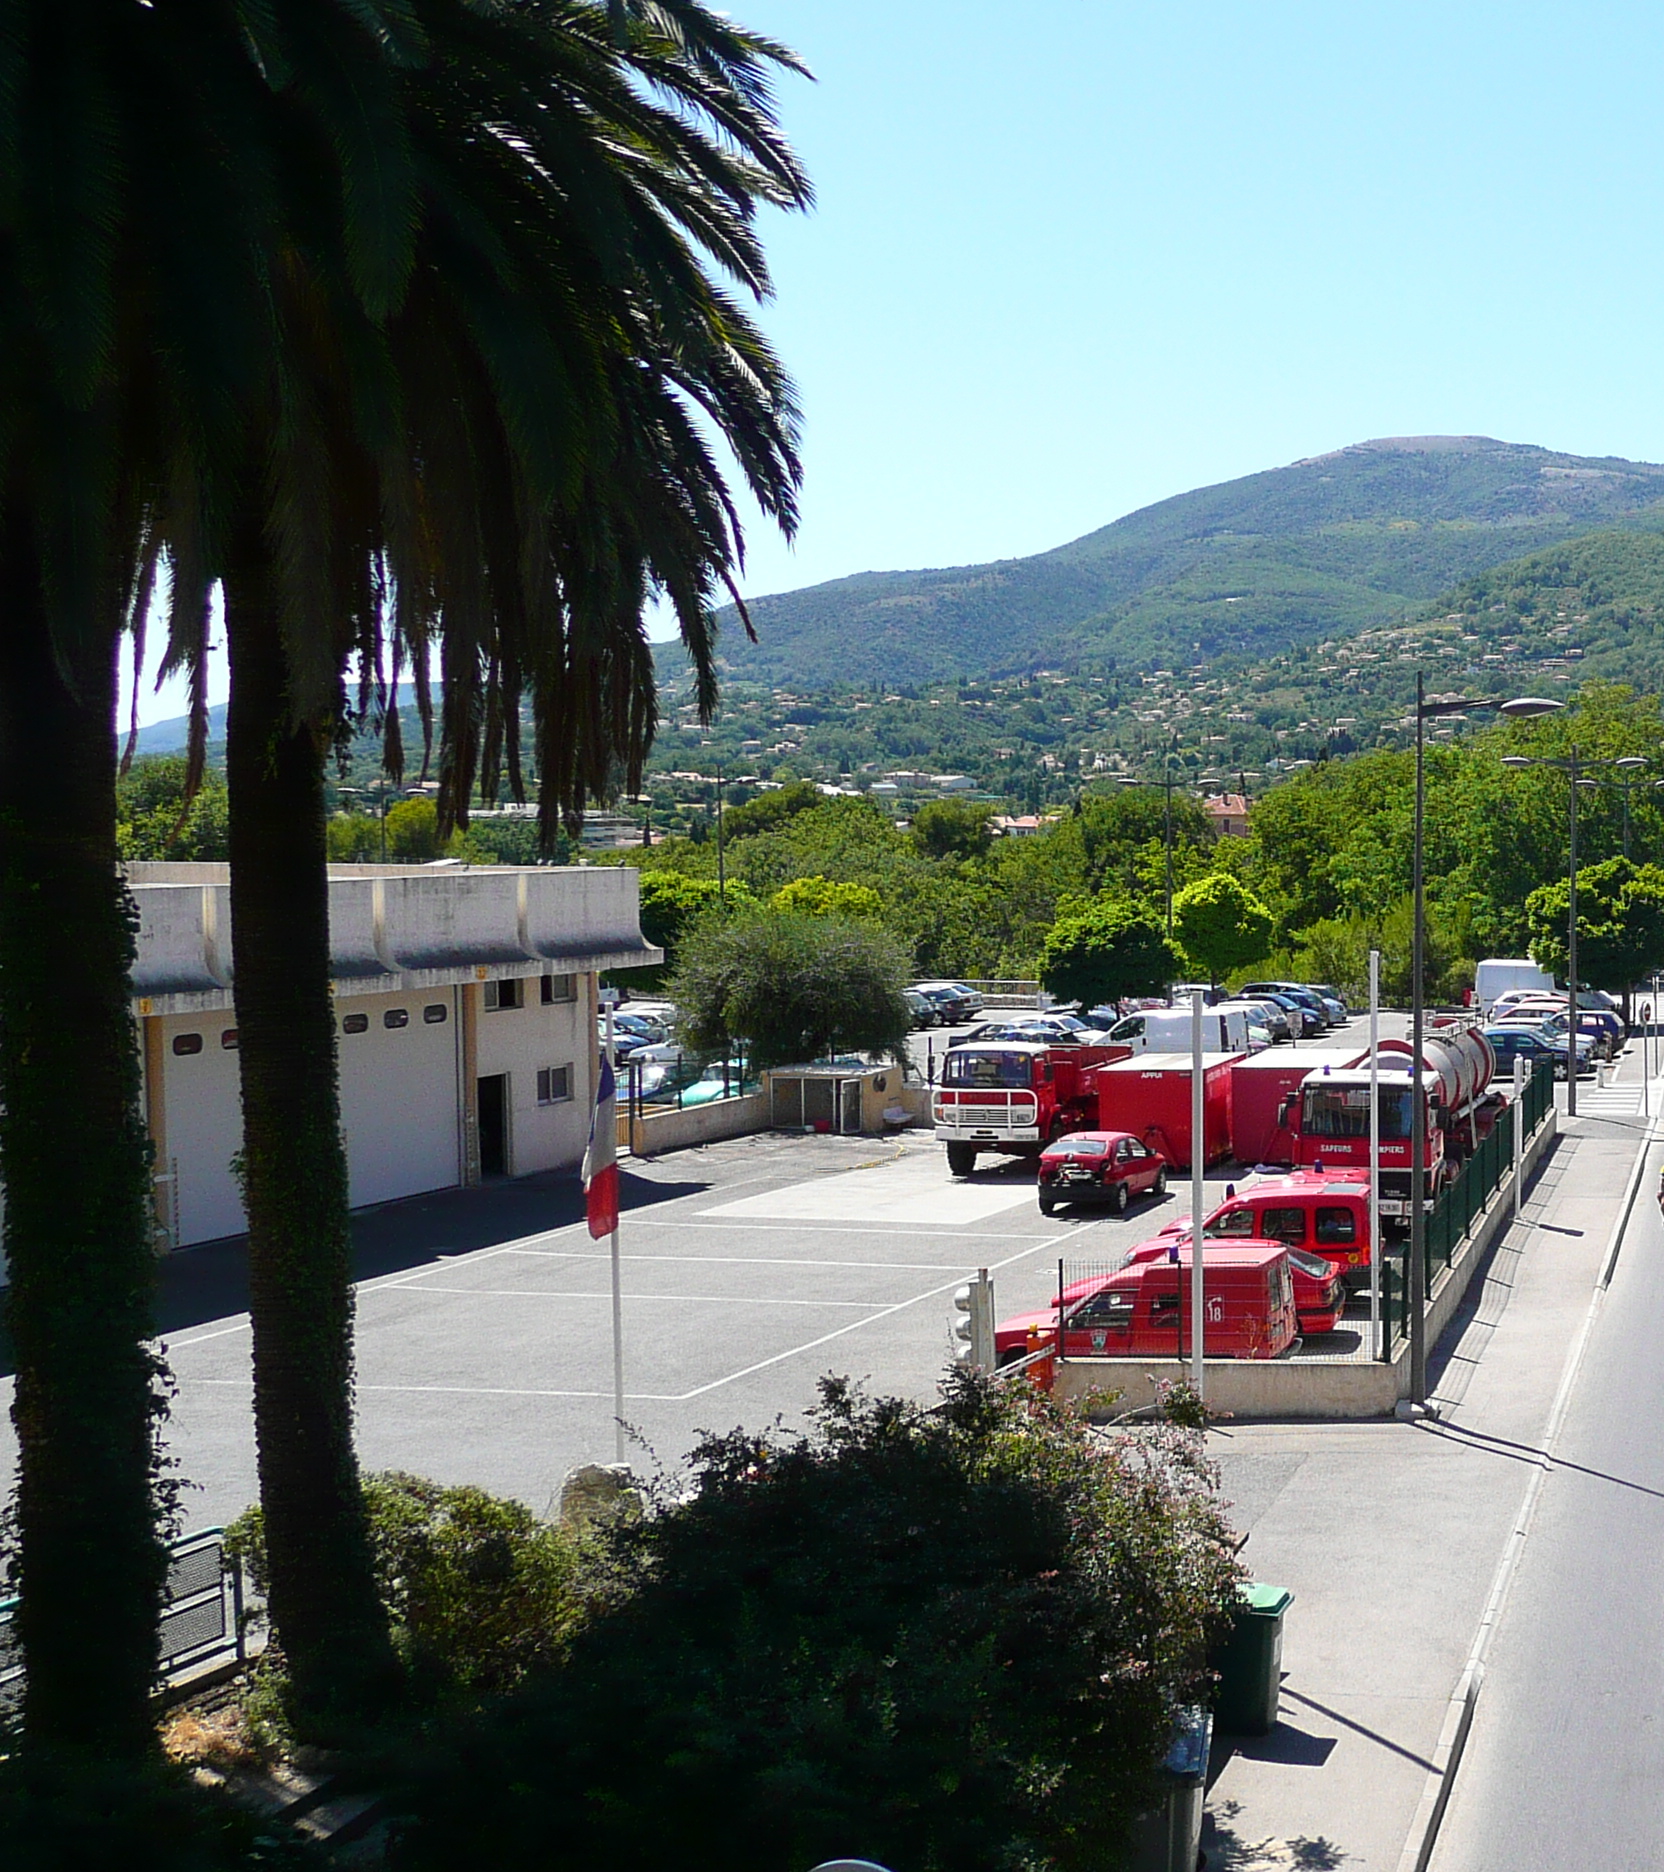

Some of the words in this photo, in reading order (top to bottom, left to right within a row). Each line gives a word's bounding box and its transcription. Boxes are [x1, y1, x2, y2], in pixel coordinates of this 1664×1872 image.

[1320, 1145, 1352, 1153] SAPEURS
[1369, 1145, 1404, 1153] MPIERS
[1209, 1307, 1222, 1321] 18
